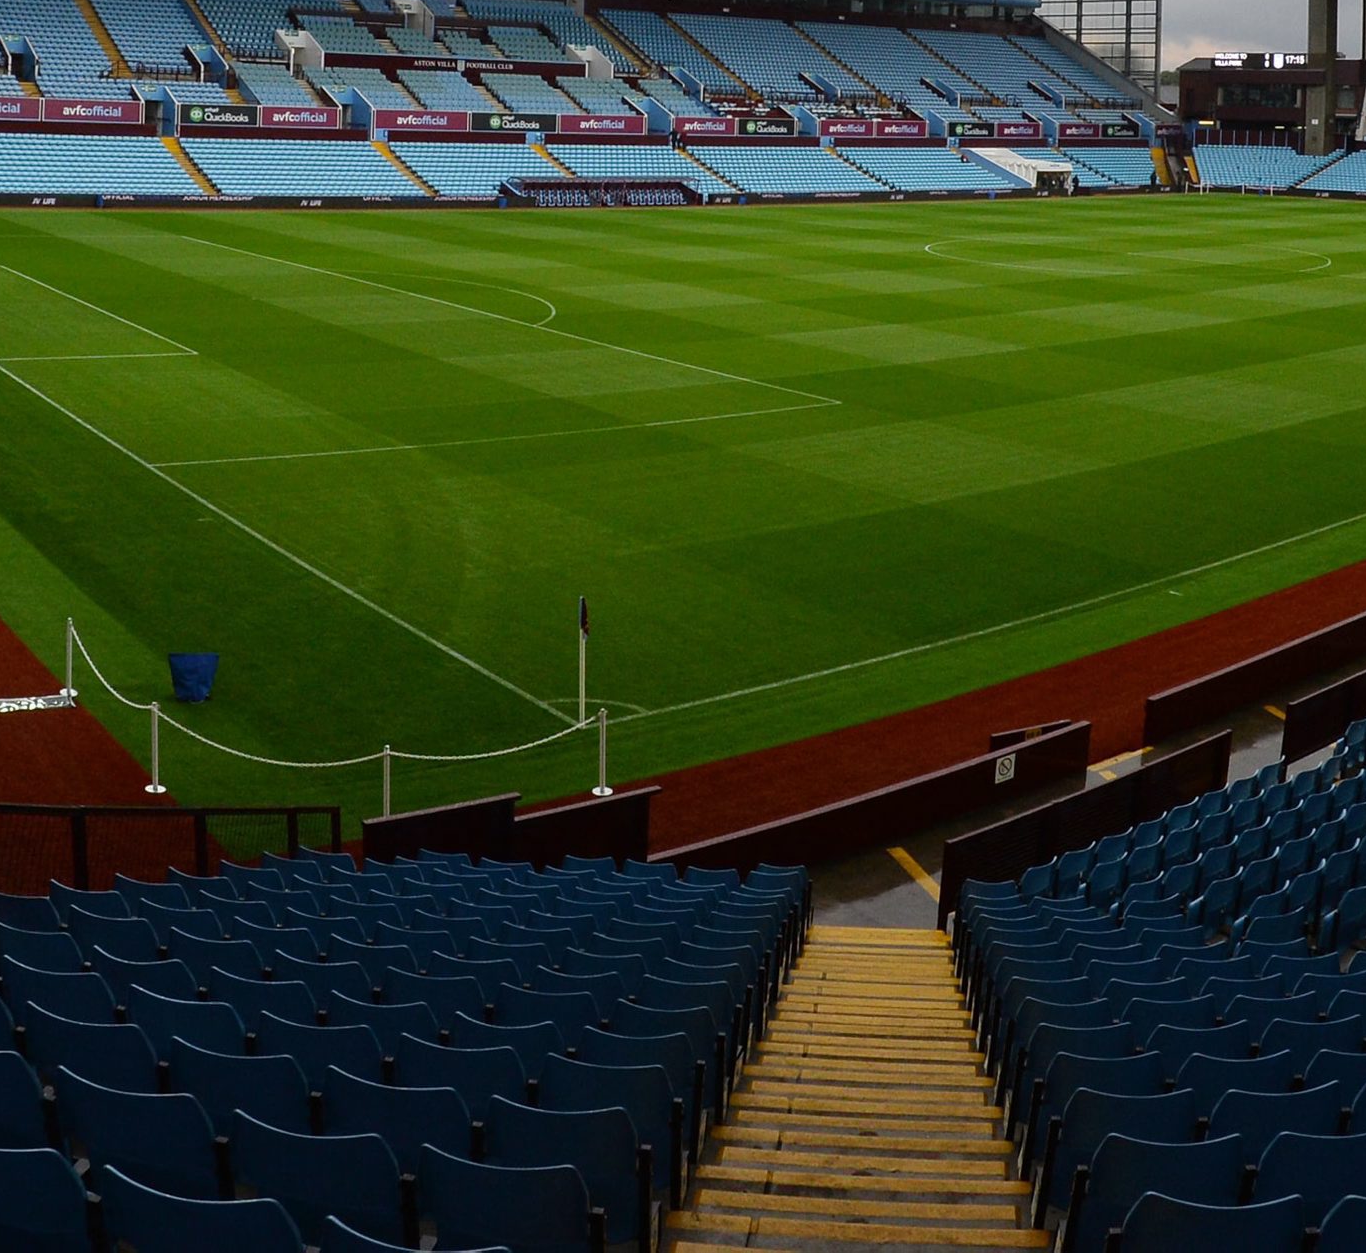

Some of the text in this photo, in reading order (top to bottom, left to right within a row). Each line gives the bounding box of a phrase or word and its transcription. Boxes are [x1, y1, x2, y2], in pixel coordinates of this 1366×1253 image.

[1285, 54, 1305, 65] 17:15
[62, 105, 122, 118] avfcofficial
[272, 111, 327, 123] avfcofficial
[204, 112, 249, 123] QuickBooks
[396, 114, 448, 126] avfcofficial
[501, 120, 540, 130] QuickBooks
[579, 118, 625, 130] avfcofficial
[683, 121, 726, 132] avfcofficial
[828, 123, 866, 134] avfcofficial
